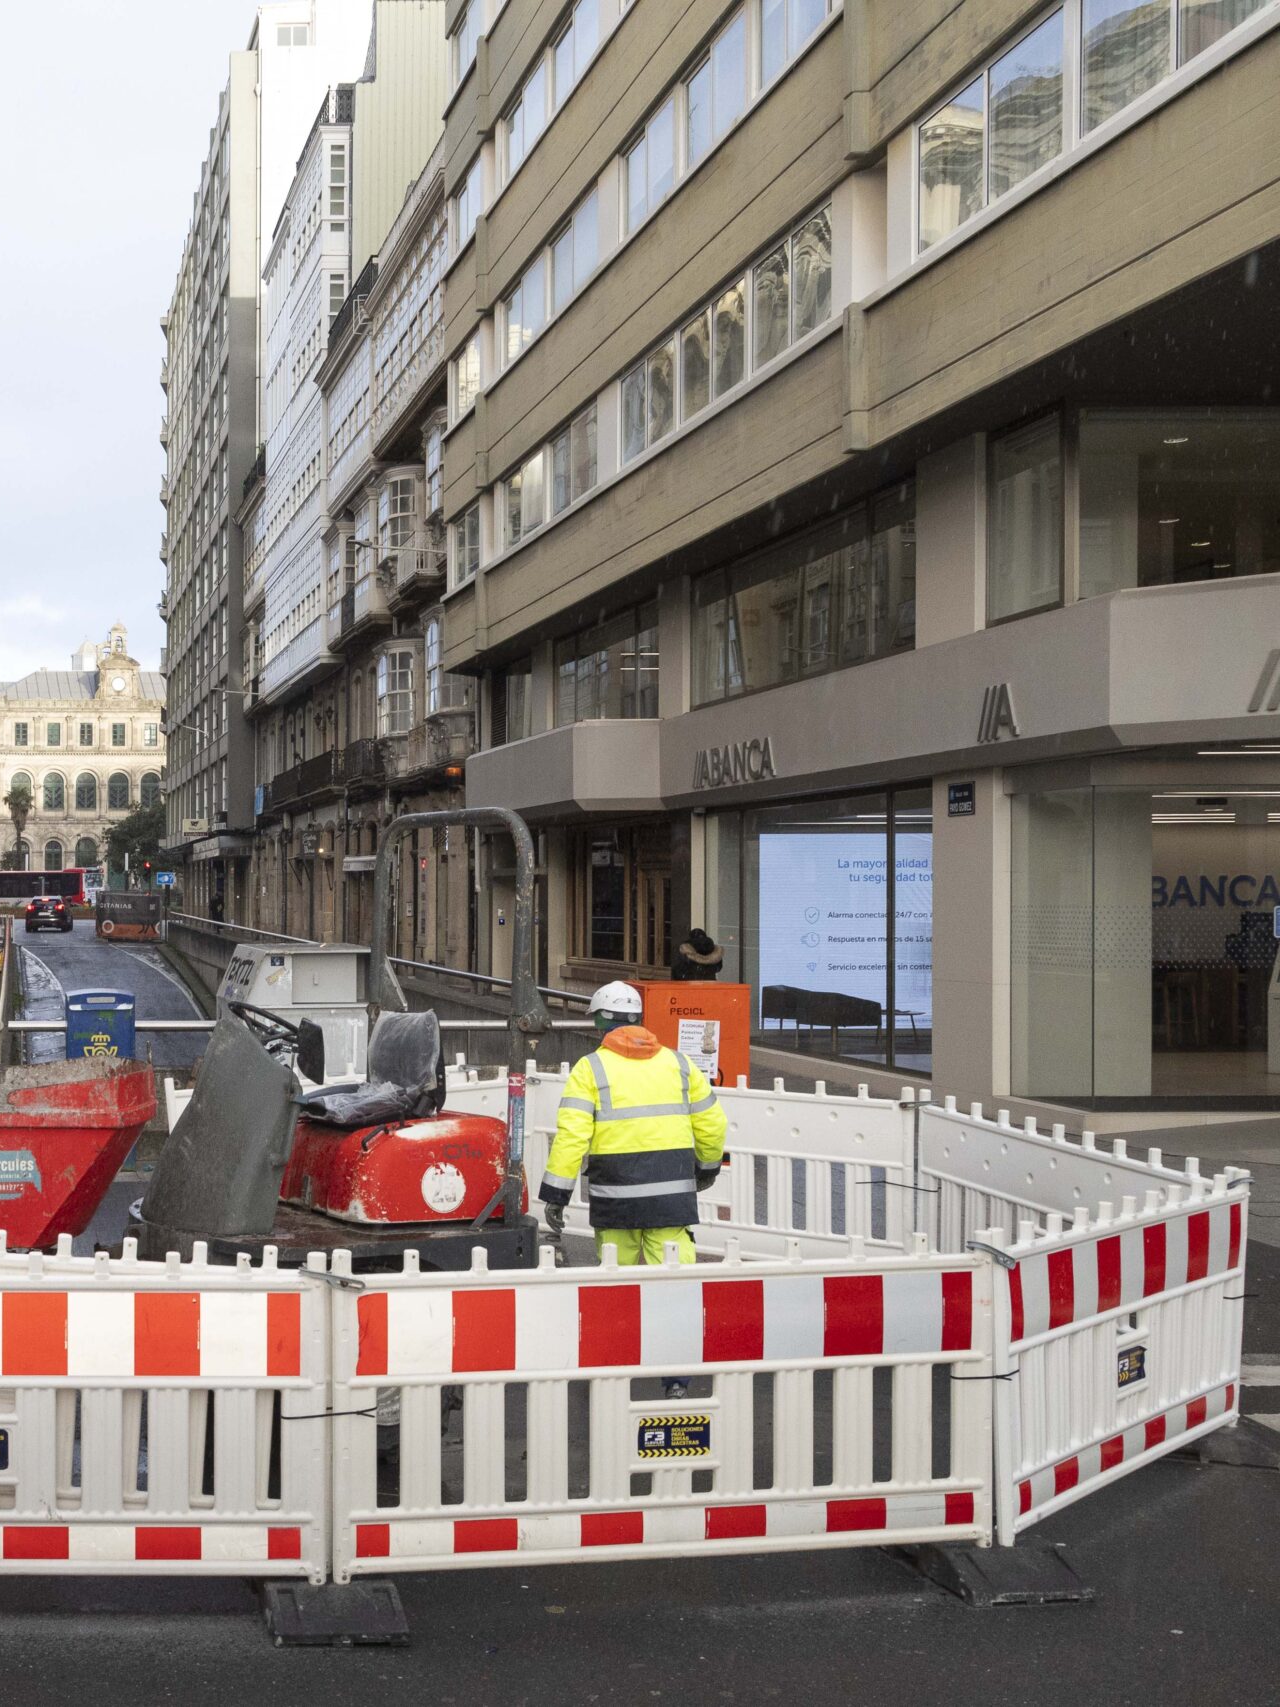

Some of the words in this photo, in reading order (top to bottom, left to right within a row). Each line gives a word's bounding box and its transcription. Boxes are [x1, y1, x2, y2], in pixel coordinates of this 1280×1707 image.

[838, 859, 850, 868] La
[849, 873, 860, 882] tu
[827, 911, 854, 919] Alarma
[827, 936, 865, 944] Respuesta
[827, 963, 857, 971] Servicio
[670, 997, 677, 1005] C
[670, 1007, 705, 1016] PECICL
[644, 1432, 665, 1441] F3
